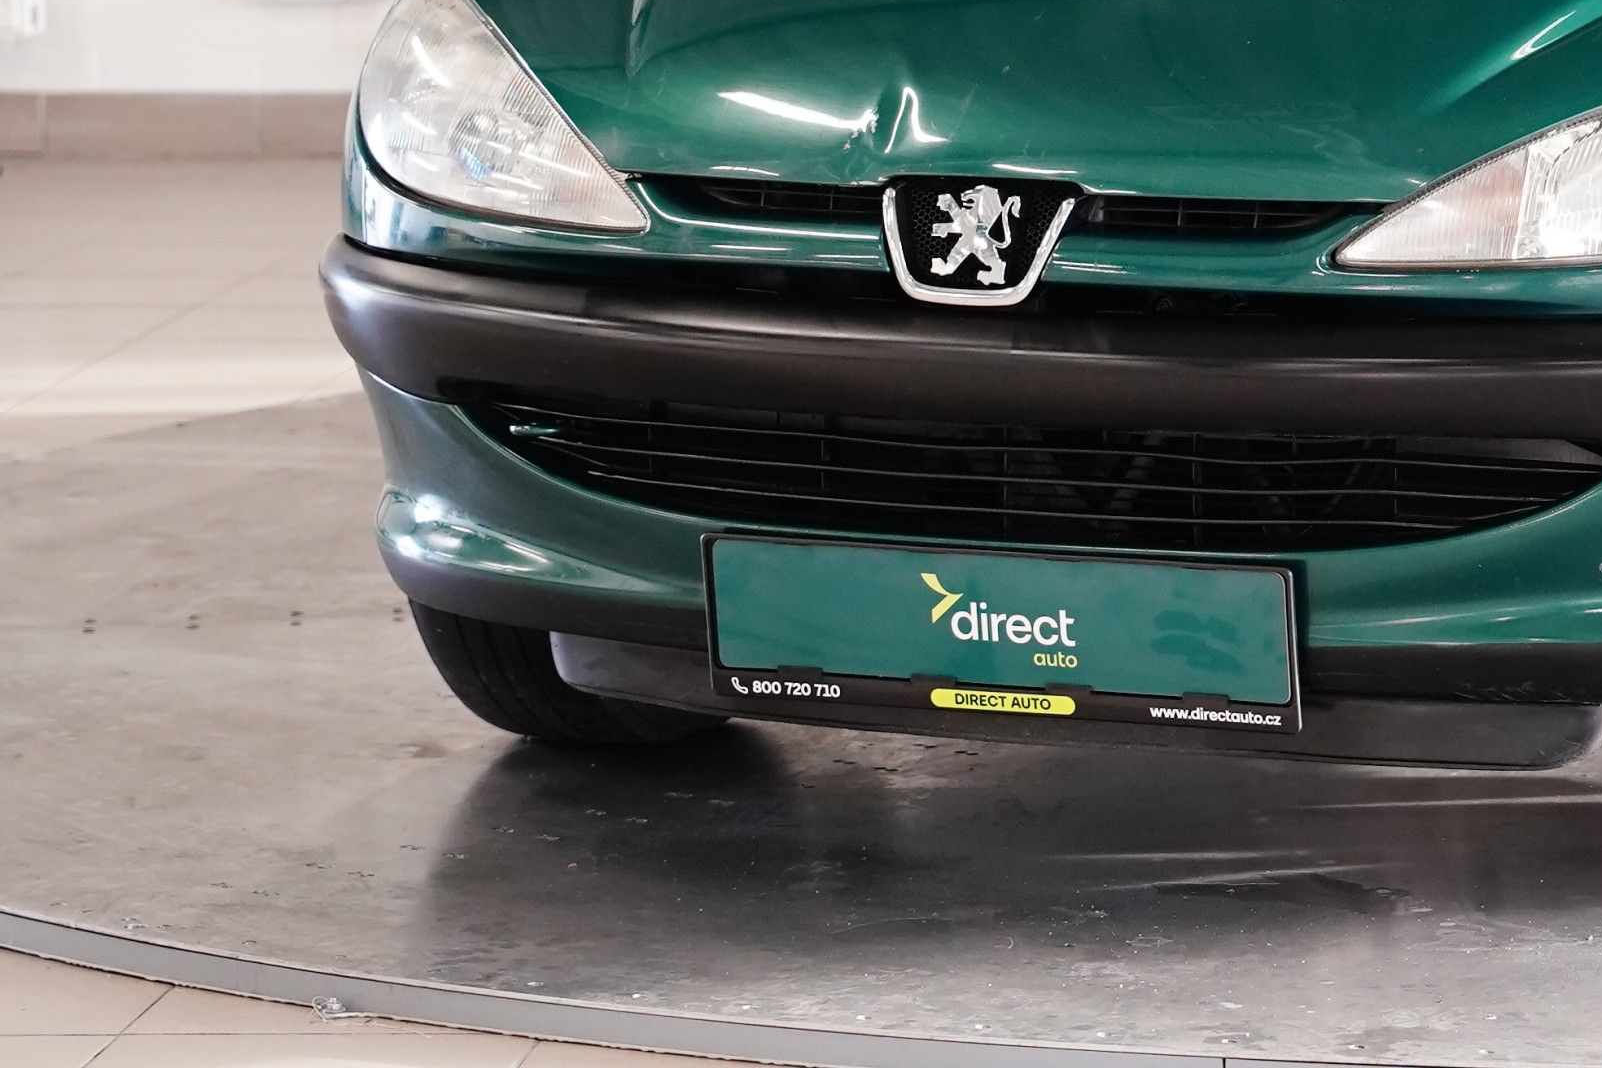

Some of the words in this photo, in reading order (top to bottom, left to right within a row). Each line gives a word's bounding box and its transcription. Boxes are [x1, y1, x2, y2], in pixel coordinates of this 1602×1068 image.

[950, 601, 1077, 647] direct
[1033, 651, 1078, 668] auto
[752, 680, 782, 695] 800
[784, 682, 812, 696] 720
[814, 683, 841, 698] 710
[954, 693, 1007, 708] DIRECT
[1011, 696, 1052, 711] AUTO
[1149, 707, 1282, 726] www.directauto.cz
